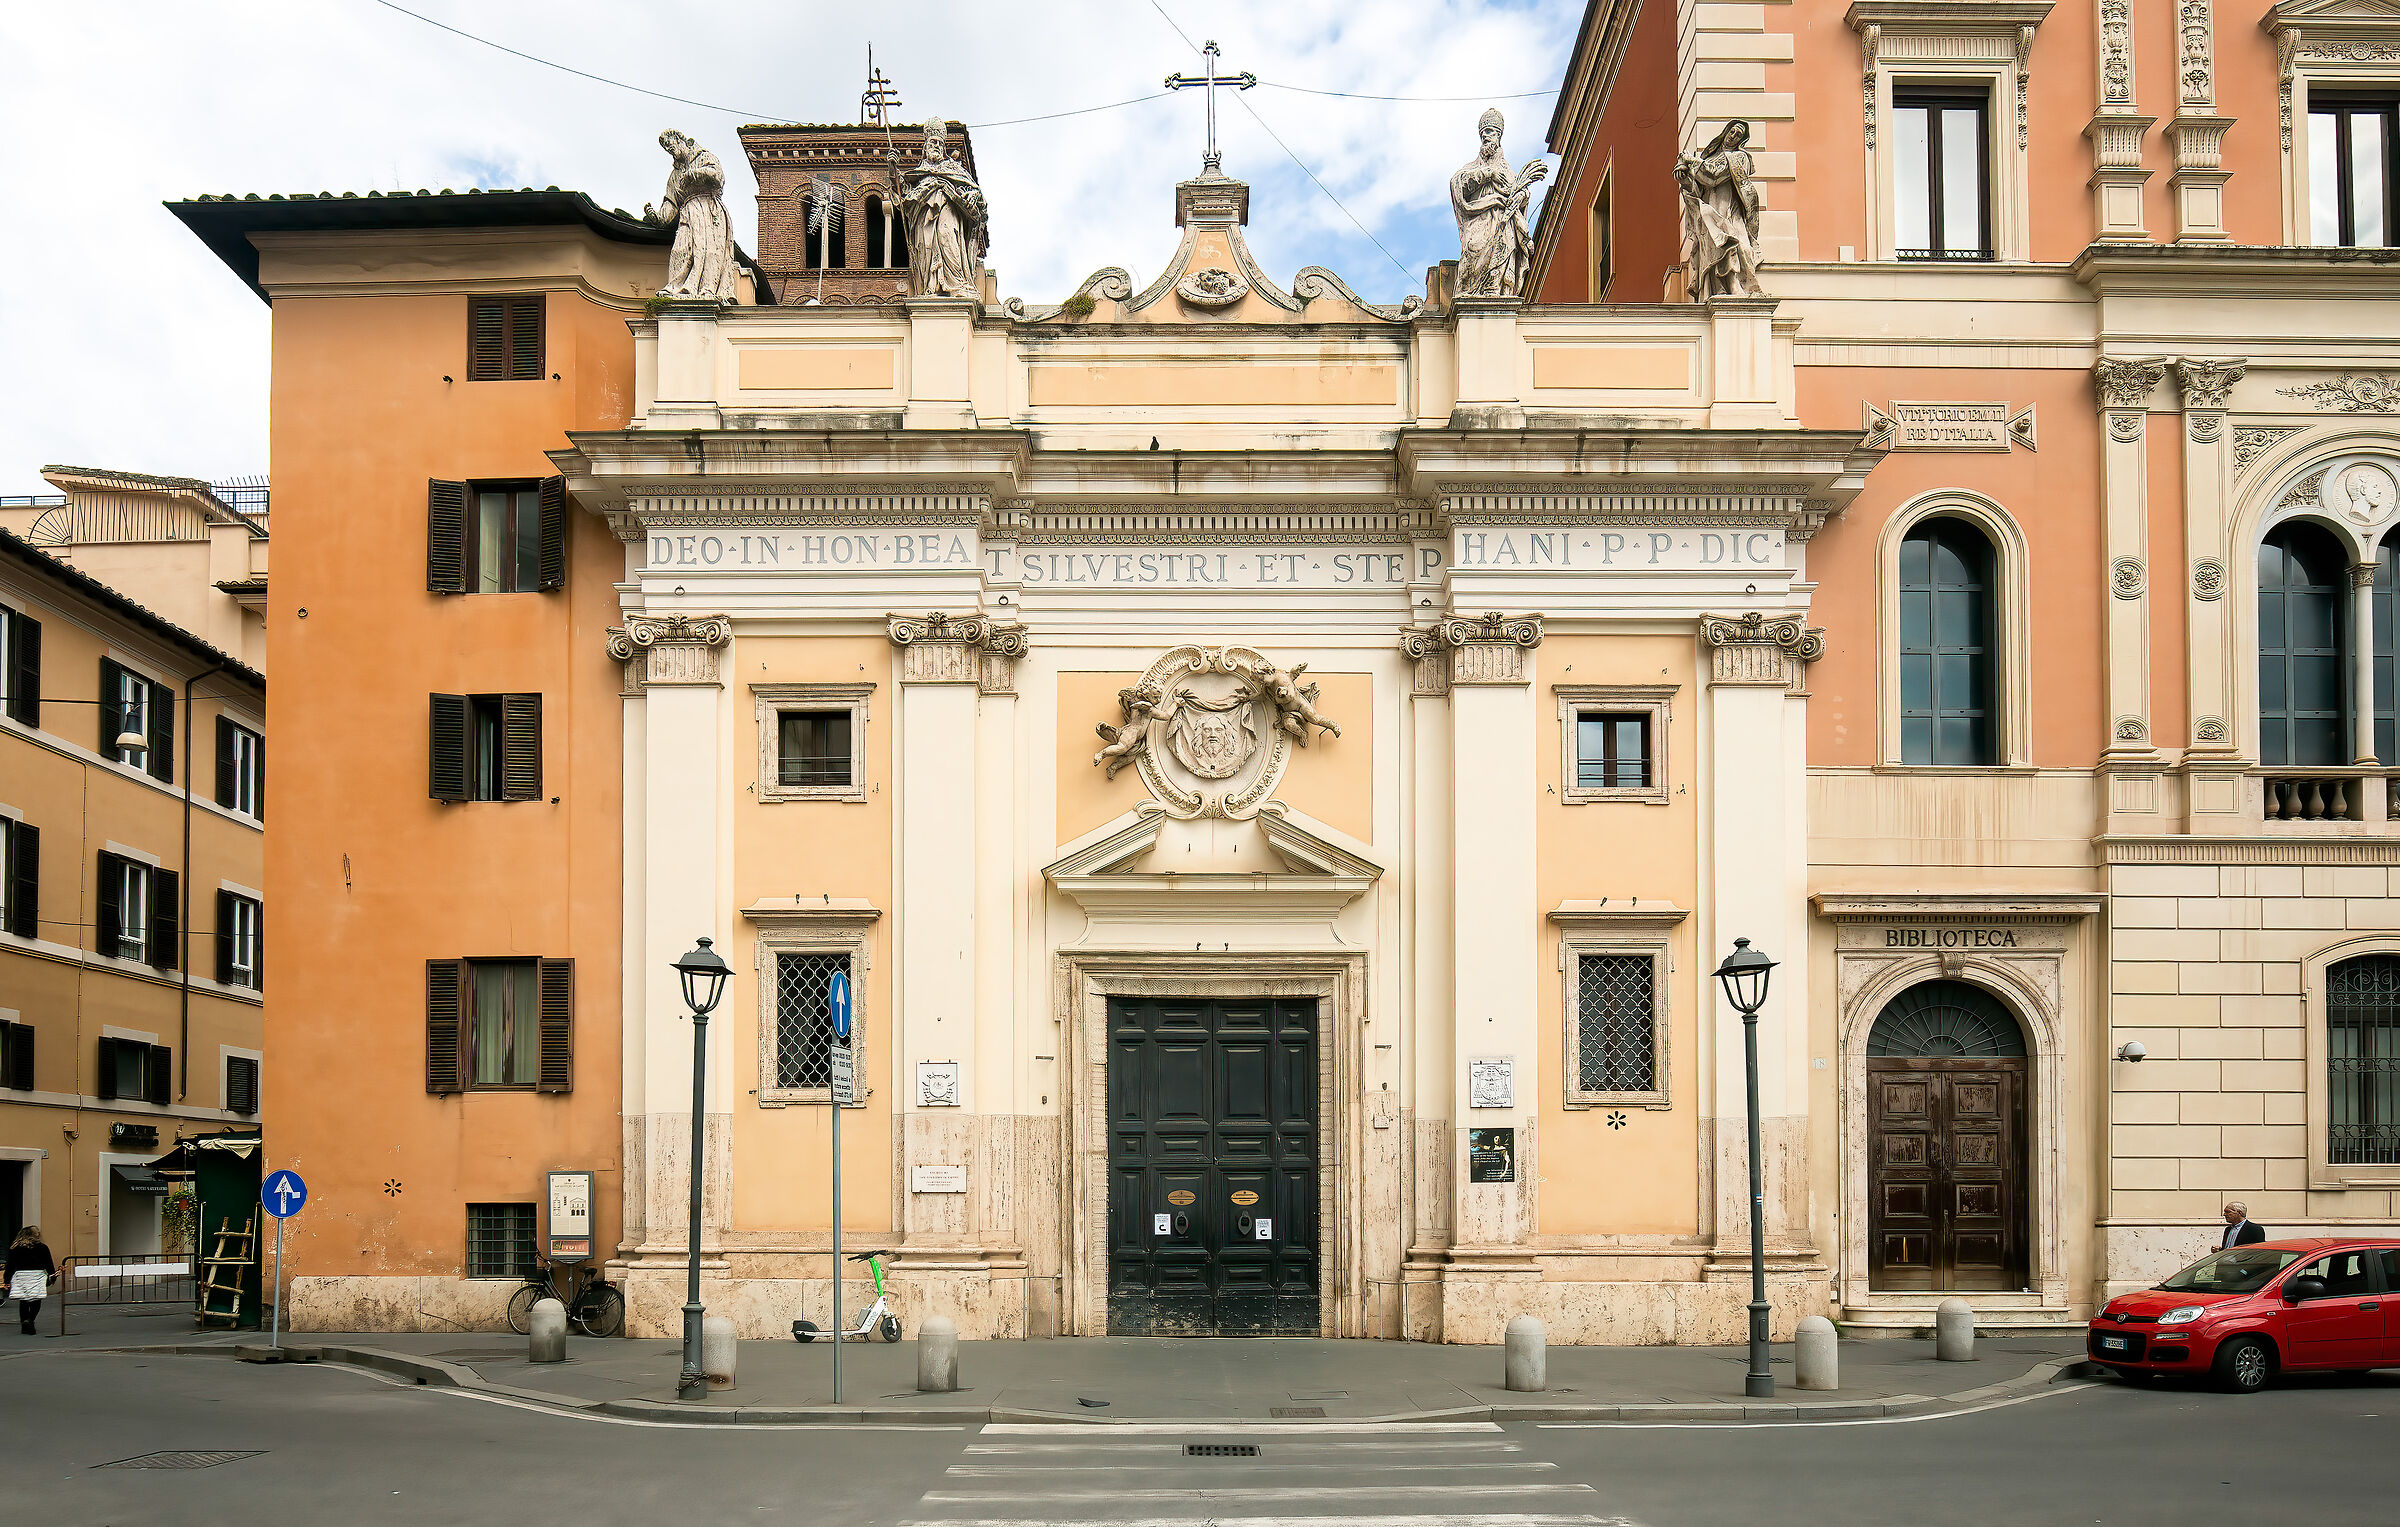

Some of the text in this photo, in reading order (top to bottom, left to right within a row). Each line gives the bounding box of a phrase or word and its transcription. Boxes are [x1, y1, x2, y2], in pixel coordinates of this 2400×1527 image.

[1906, 428, 1926, 441] RE
[651, 535, 724, 565] DEO
[740, 536, 780, 564] IN
[802, 535, 880, 564] HON
[1022, 553, 1228, 583] SILVESTRI
[1255, 553, 1306, 583] ET
[1600, 533, 1625, 564] P
[1648, 533, 1673, 564] P
[1699, 533, 1770, 564] DIC
[1885, 929, 2018, 948] BIBLIOTECA
